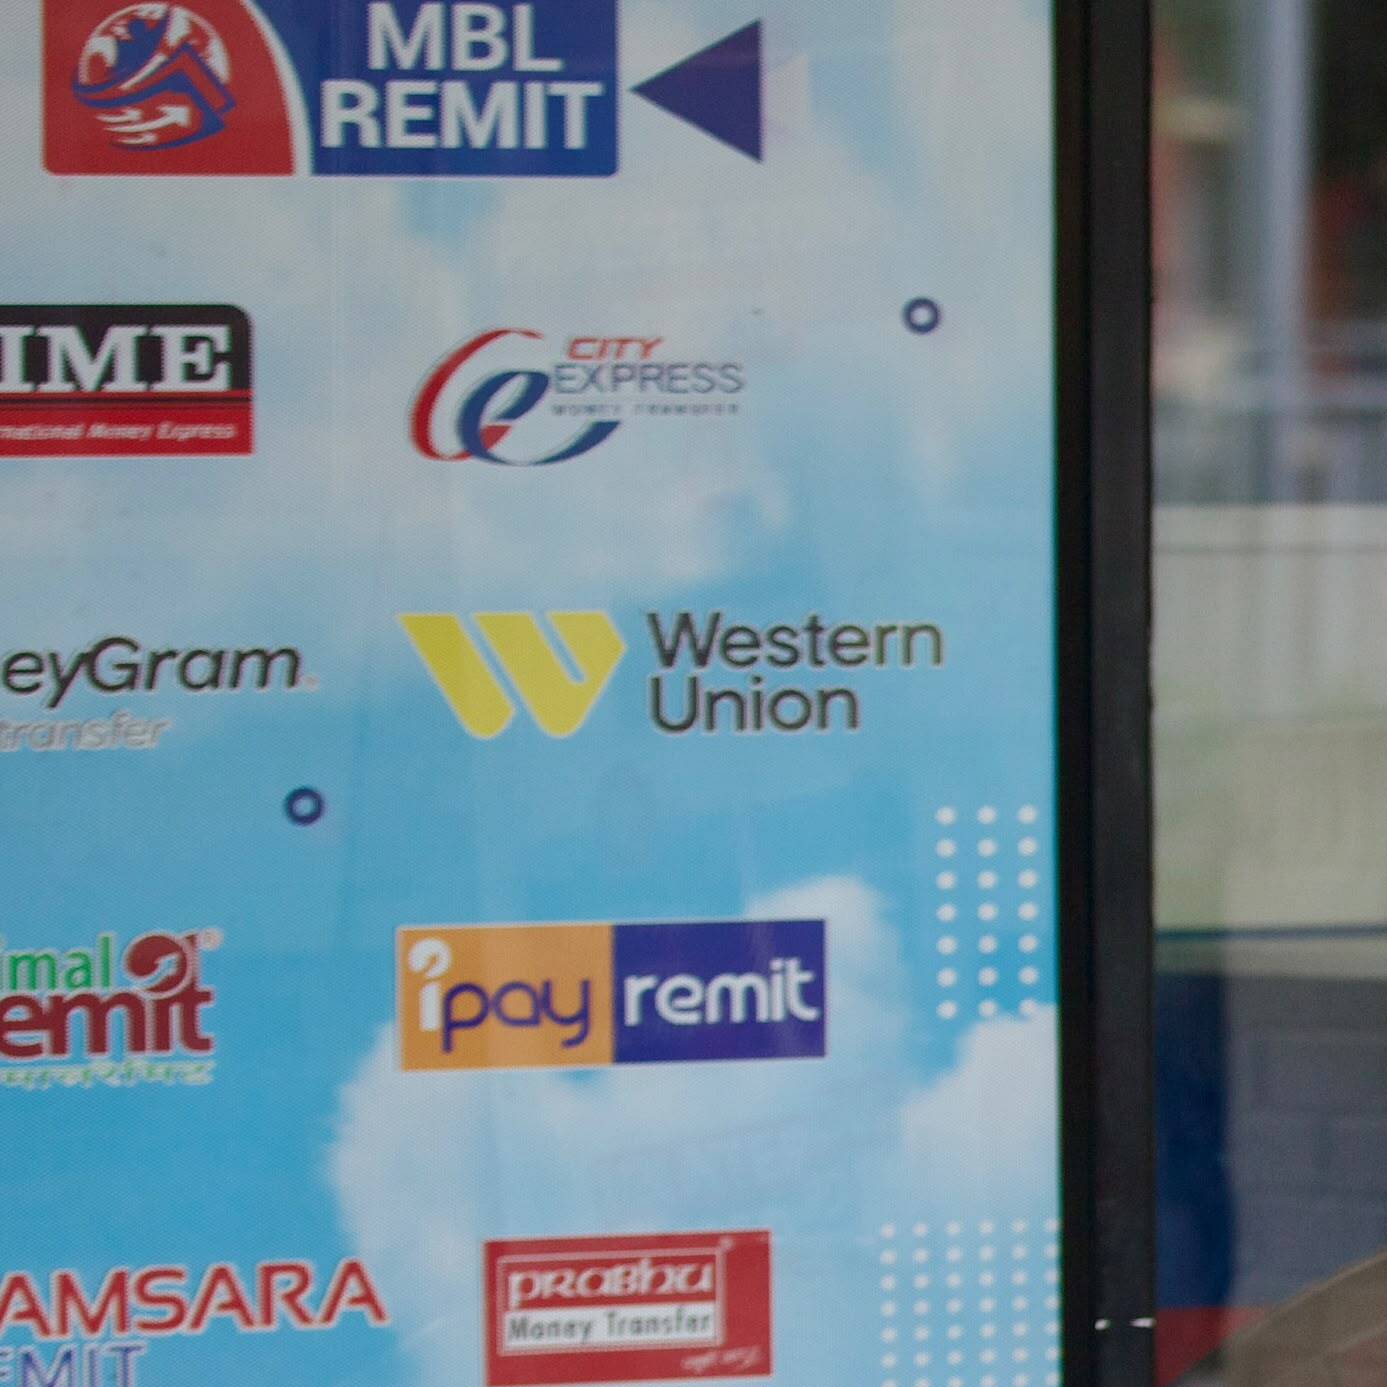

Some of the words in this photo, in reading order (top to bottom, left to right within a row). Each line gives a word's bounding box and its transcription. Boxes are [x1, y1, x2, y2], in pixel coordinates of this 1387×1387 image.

[366, 2, 564, 71] MBL
[320, 78, 604, 149] REMIT
[0, 325, 232, 391] IME
[553, 362, 745, 394] EXPRESS
[567, 336, 664, 361] CITY
[646, 611, 943, 668] Western
[649, 674, 861, 733] Union
[624, 956, 820, 1027] remit
[0, 1261, 389, 1337] AMSARA
[508, 1315, 593, 1344] Money
[605, 1306, 711, 1336] Transfer
